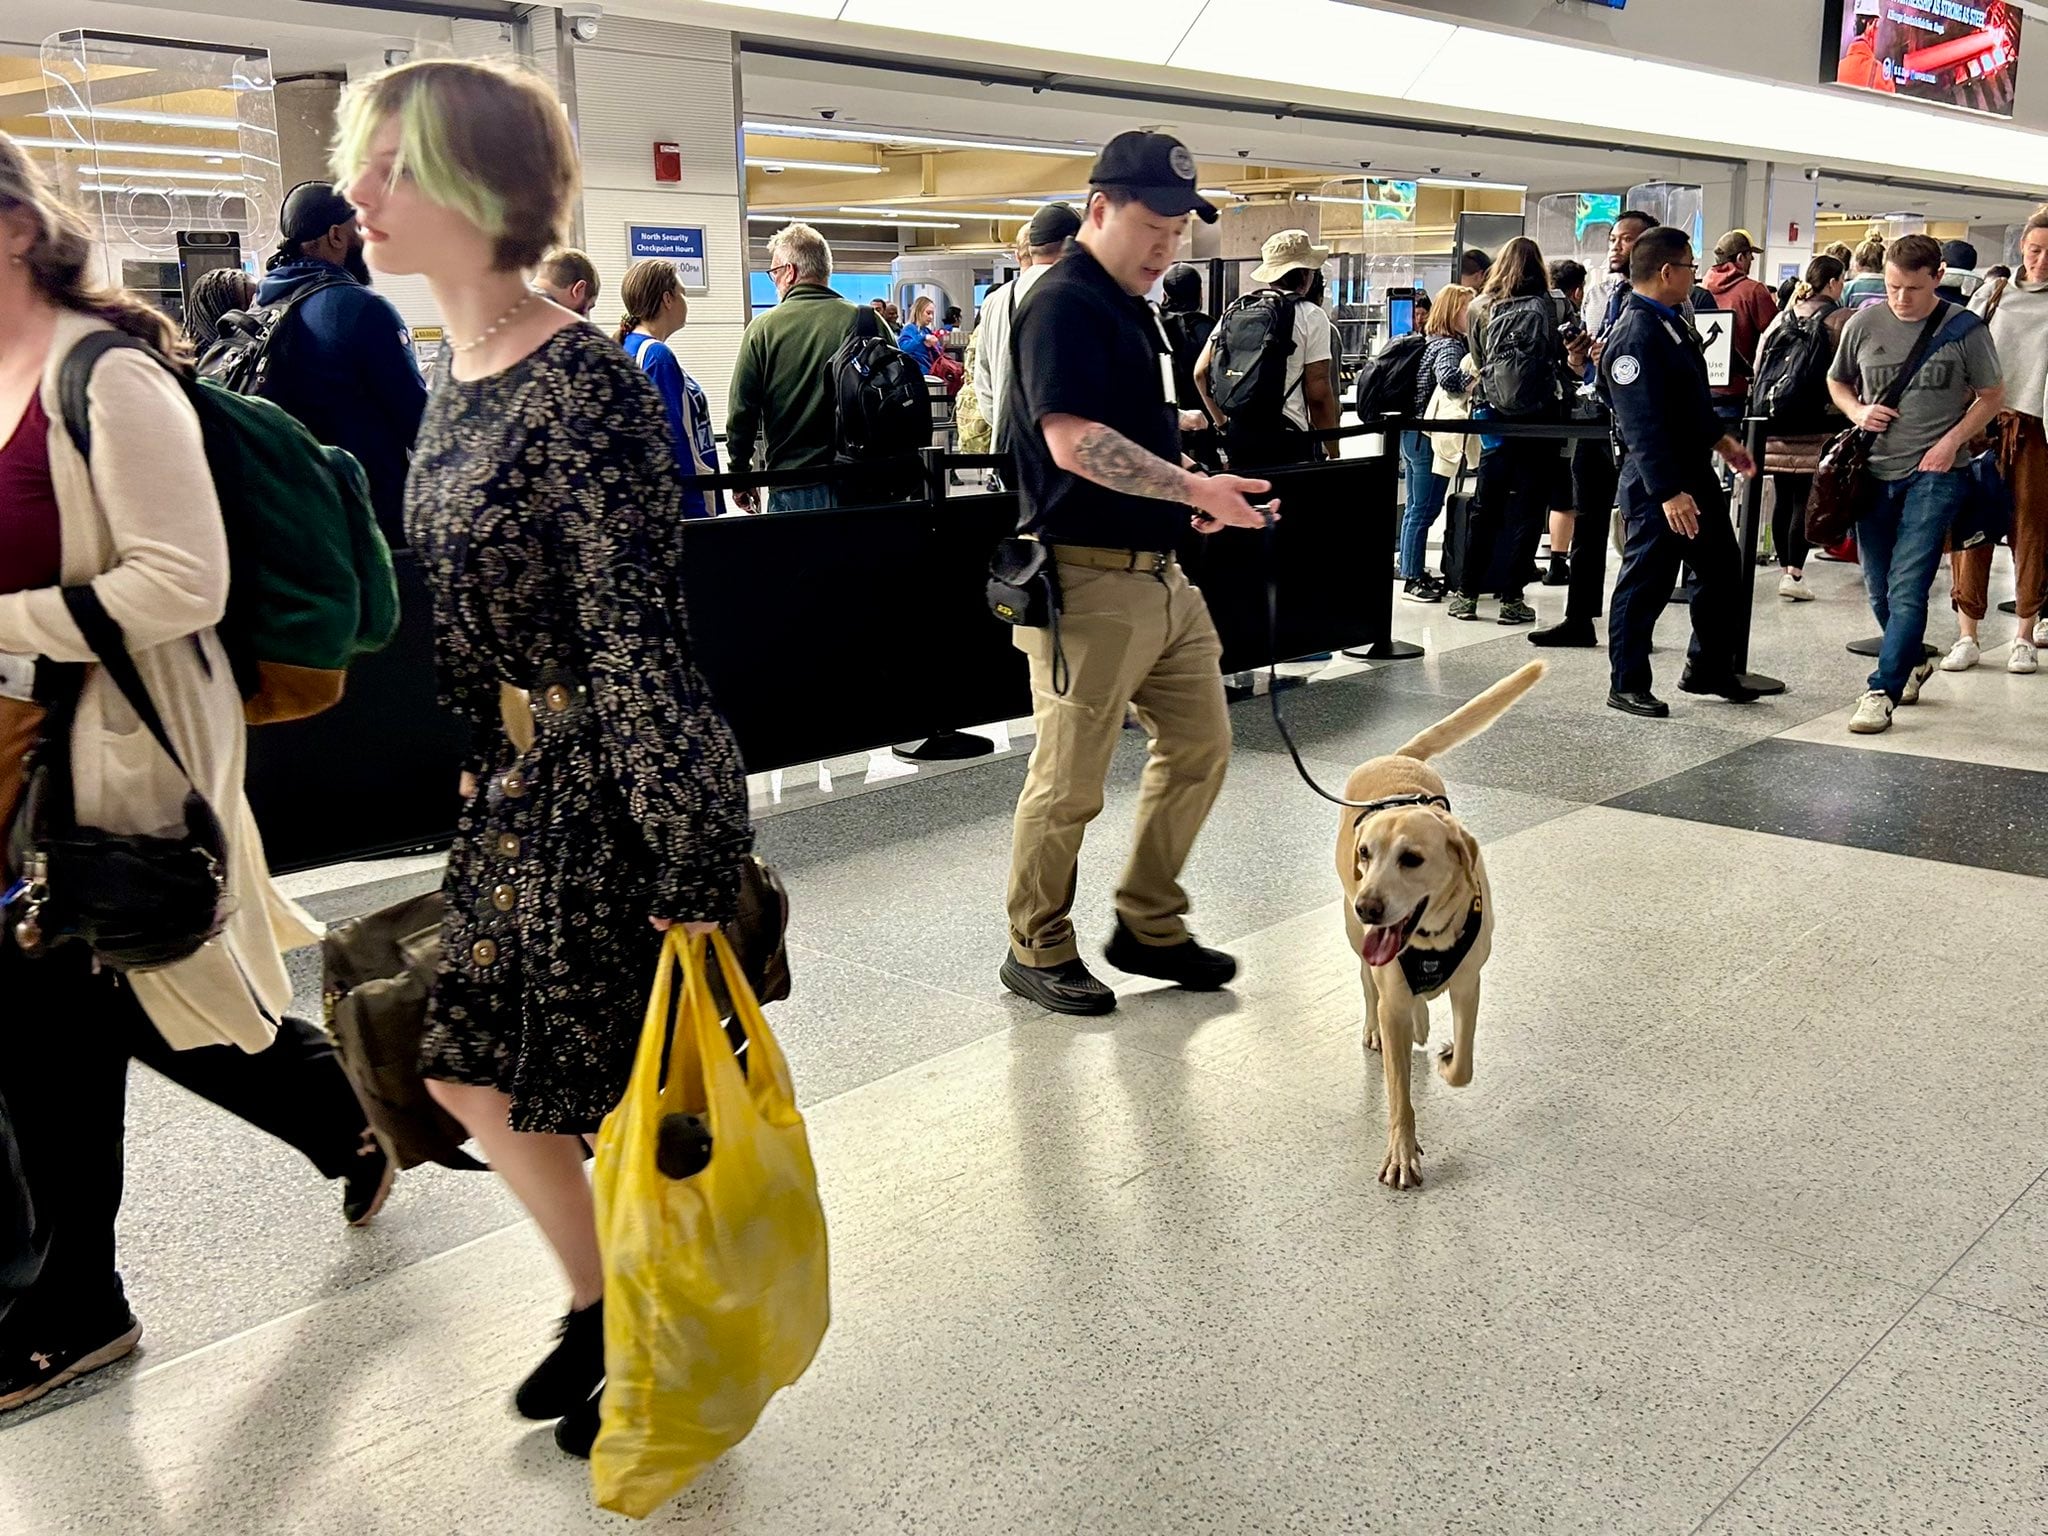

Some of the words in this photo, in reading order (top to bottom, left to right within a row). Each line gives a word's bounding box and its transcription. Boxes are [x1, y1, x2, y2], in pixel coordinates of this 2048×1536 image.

[641, 232, 661, 241] North
[662, 233, 688, 243] Security
[637, 244, 674, 253] Checkpoint
[675, 245, 694, 253] Hours
